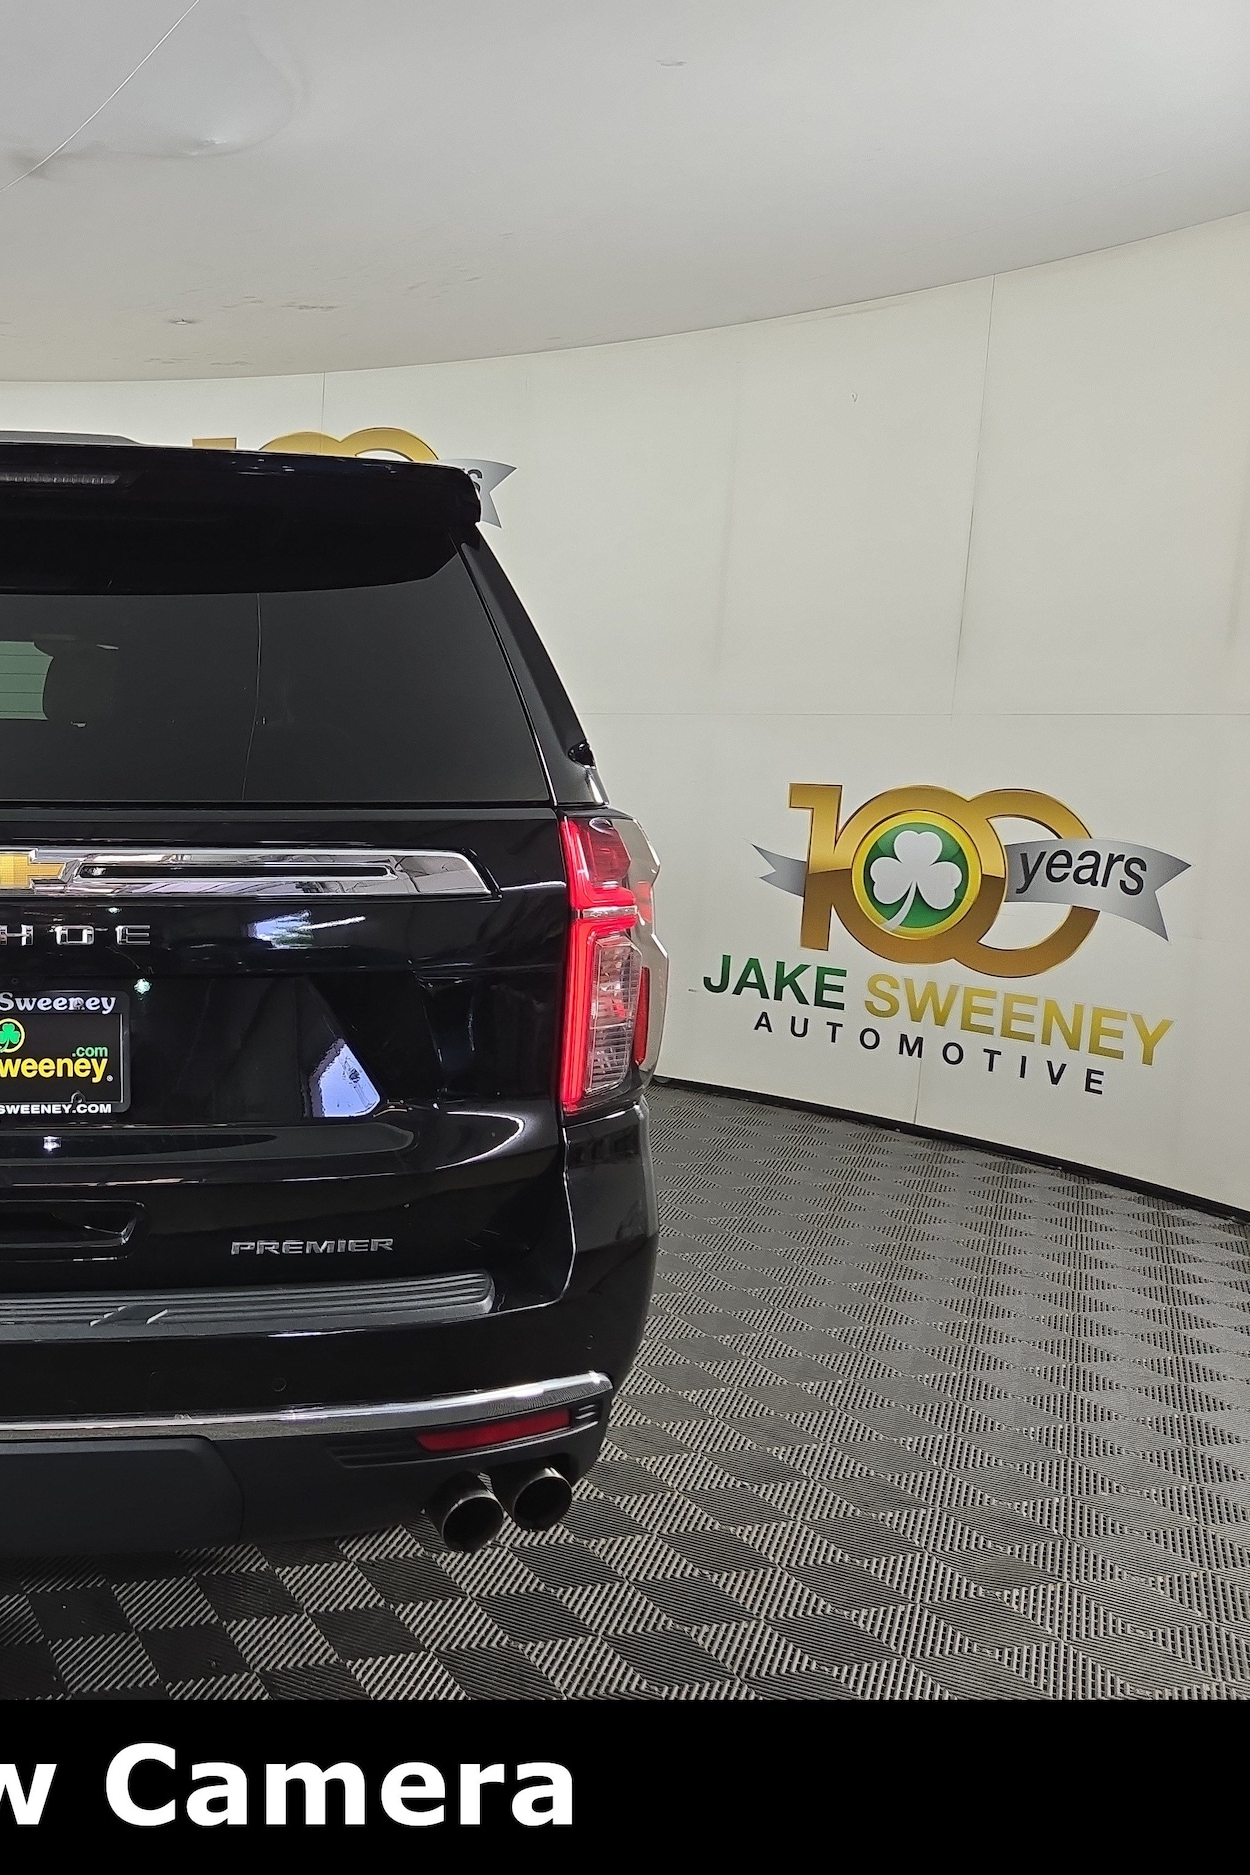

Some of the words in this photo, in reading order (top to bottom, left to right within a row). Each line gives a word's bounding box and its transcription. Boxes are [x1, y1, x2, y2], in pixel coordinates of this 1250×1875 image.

[1015, 848, 1147, 896] years
[703, 953, 848, 1011] JAKE
[863, 972, 1175, 1067] SWEENEY
[753, 1011, 1106, 1096] AUTOMOTIVE
[230, 1238, 394, 1255] PREMIER
